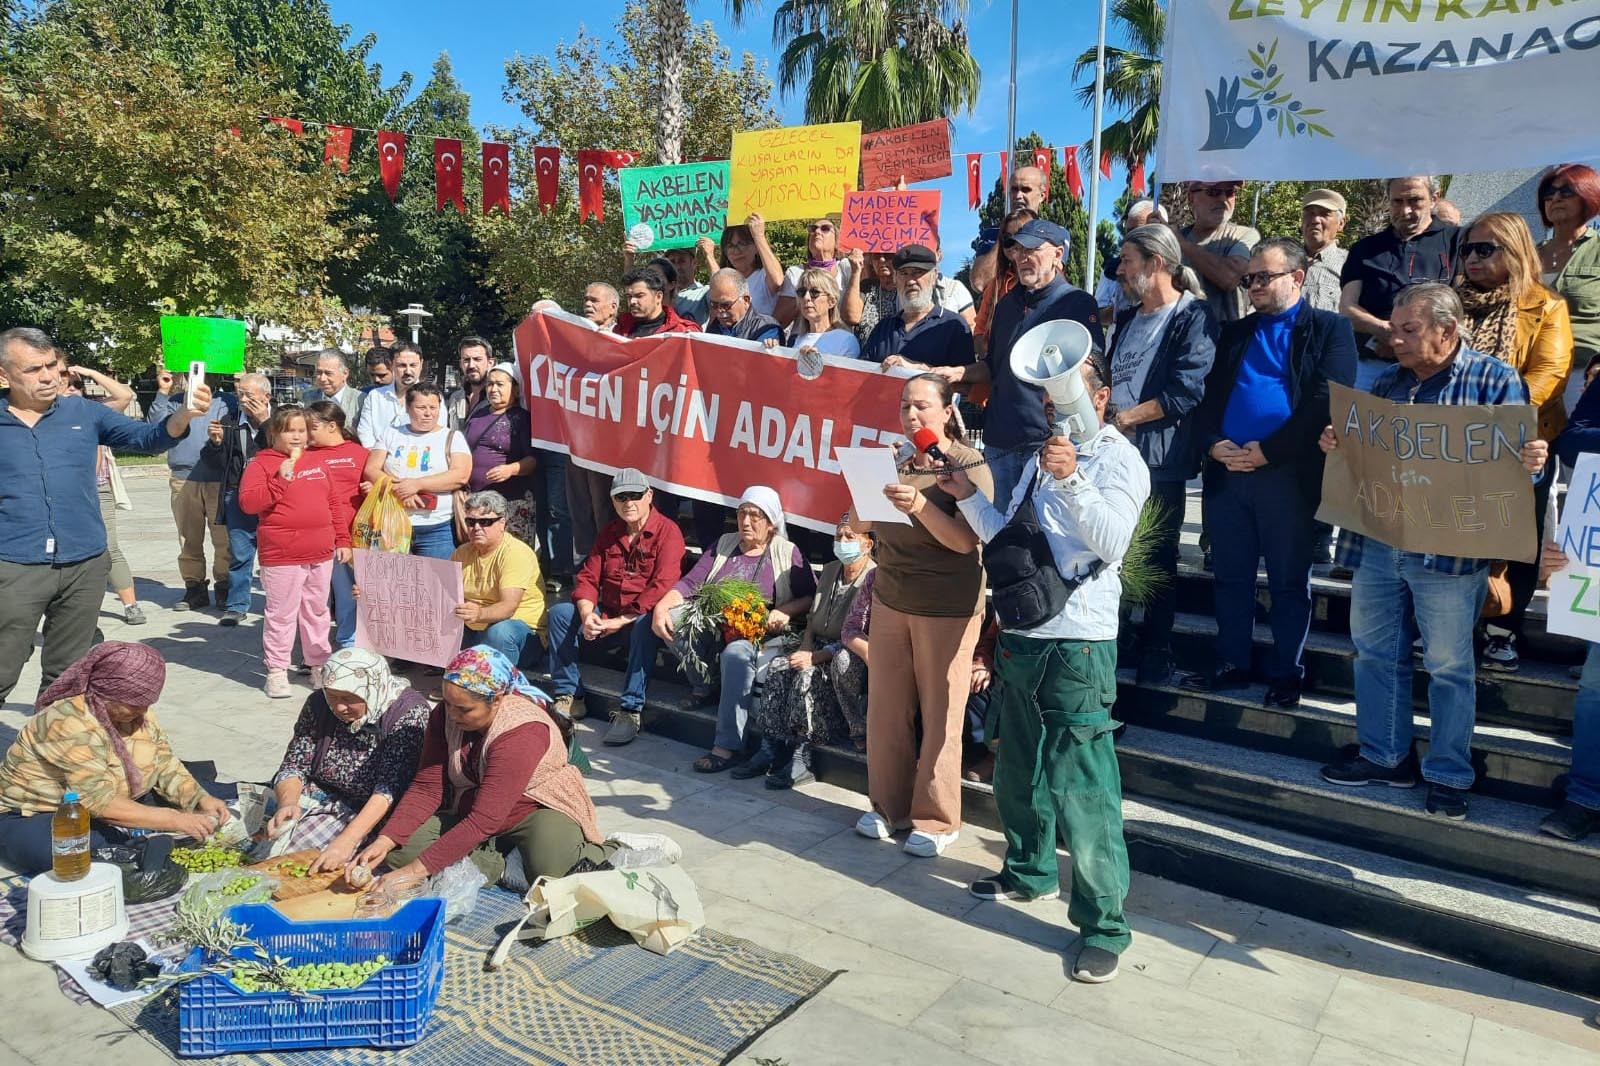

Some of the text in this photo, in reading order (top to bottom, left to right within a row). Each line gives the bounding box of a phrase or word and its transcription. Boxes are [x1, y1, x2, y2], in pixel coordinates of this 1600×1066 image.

[835, 146, 854, 160] DA
[636, 169, 723, 201] AKBELEN
[809, 165, 847, 177] HAKKI
[848, 196, 918, 211] MADENE
[636, 367, 720, 444] İÇİN
[1344, 402, 1526, 465] AKBELEN
[1391, 464, 1432, 487] için
[1353, 480, 1520, 533] ADALET
[1568, 574, 1600, 616] Z
